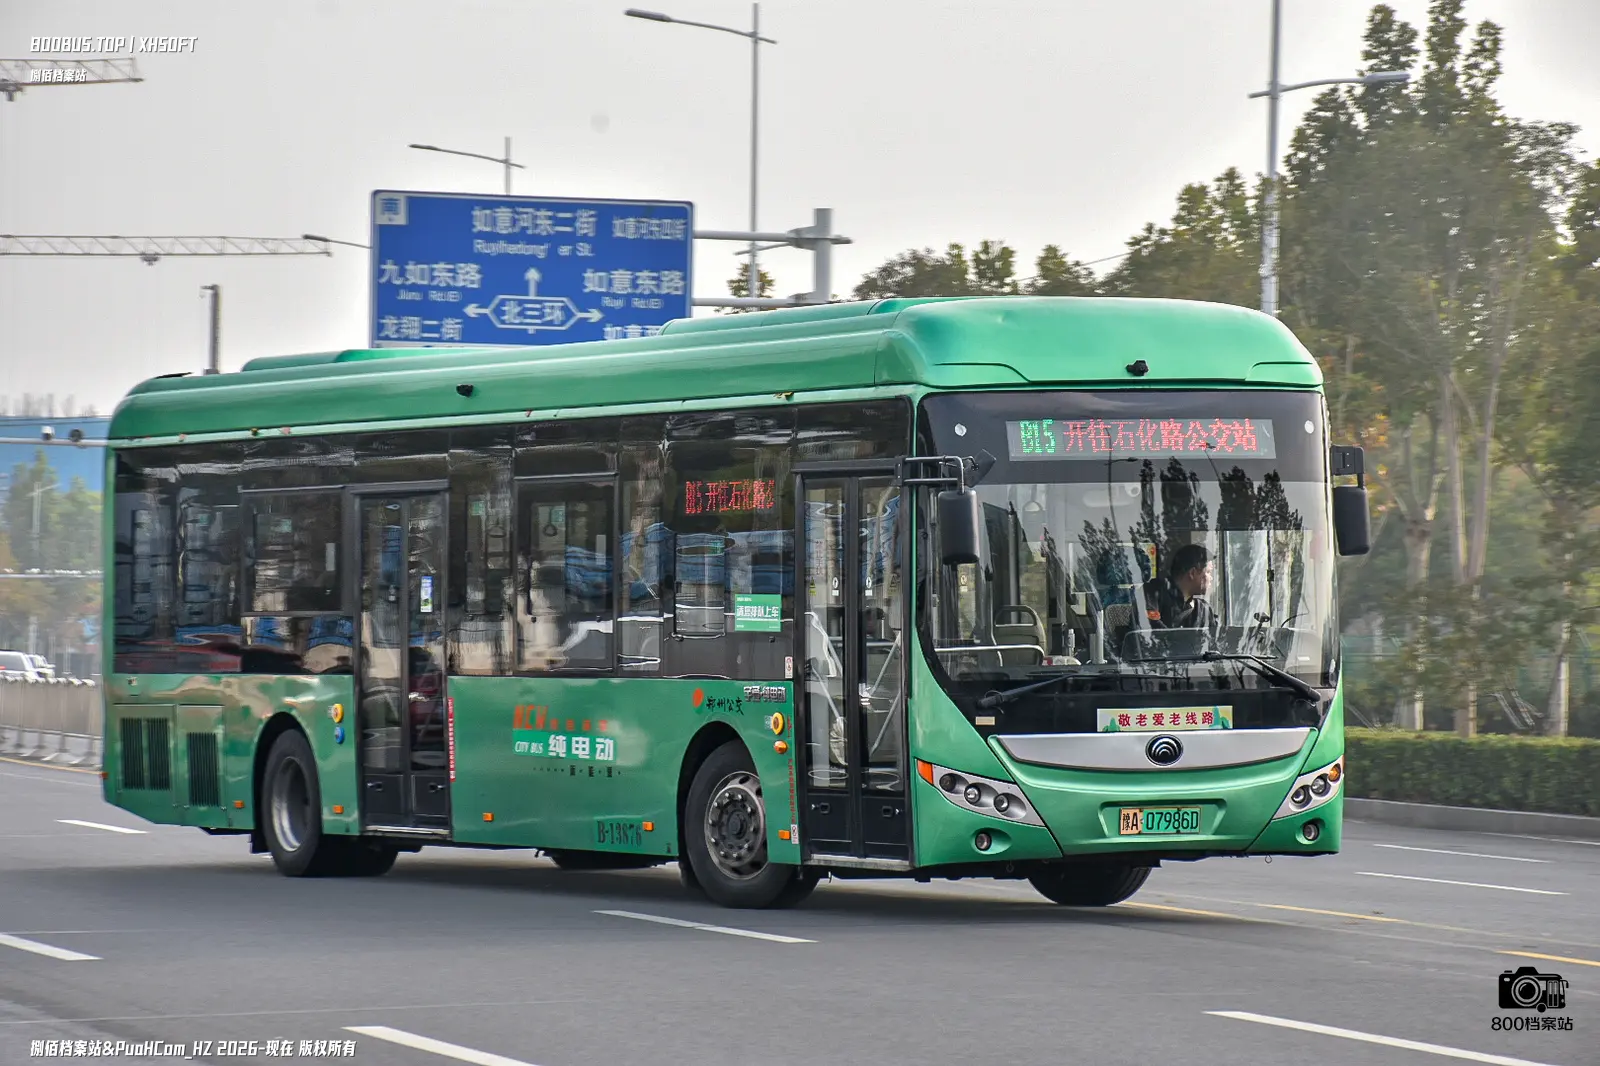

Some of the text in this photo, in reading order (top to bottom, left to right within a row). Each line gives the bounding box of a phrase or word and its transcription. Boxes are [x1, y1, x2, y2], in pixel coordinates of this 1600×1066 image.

[472, 206, 598, 237] 如意河东二街
[379, 260, 482, 289] 九如东路
[582, 269, 685, 295] 如意东路
[502, 300, 566, 325] 北三环
[1063, 418, 1258, 453] 开往石化路公交站
[706, 696, 744, 715] 郑州公交
[1117, 711, 1214, 728] 敬老爱老线路
[547, 734, 614, 760] 纯电动
